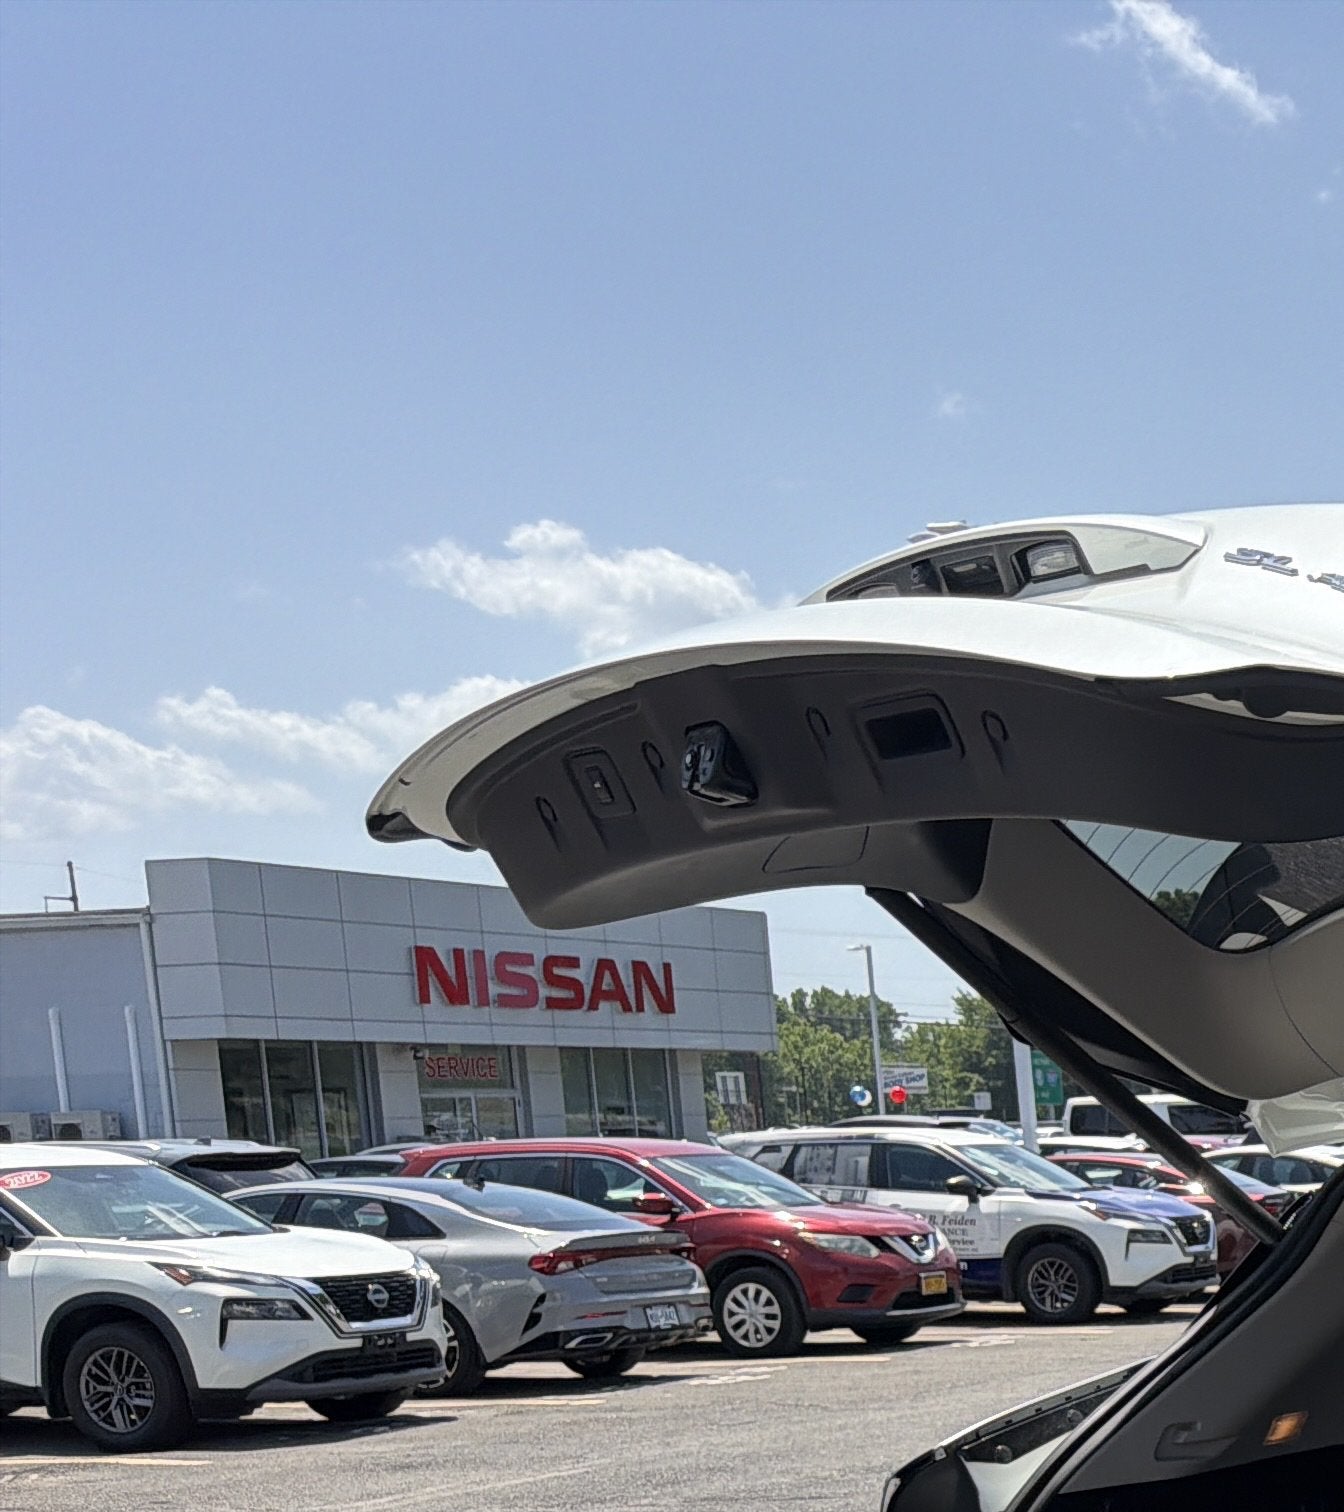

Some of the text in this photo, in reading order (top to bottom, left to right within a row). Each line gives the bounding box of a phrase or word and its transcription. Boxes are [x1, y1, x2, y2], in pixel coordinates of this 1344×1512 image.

[1222, 547, 1299, 577] SL
[413, 944, 677, 1015] NISSAN
[424, 1055, 498, 1080] SERVICE
[905, 1073, 926, 1084] SHOP
[942, 1216, 976, 1226] Feiden
